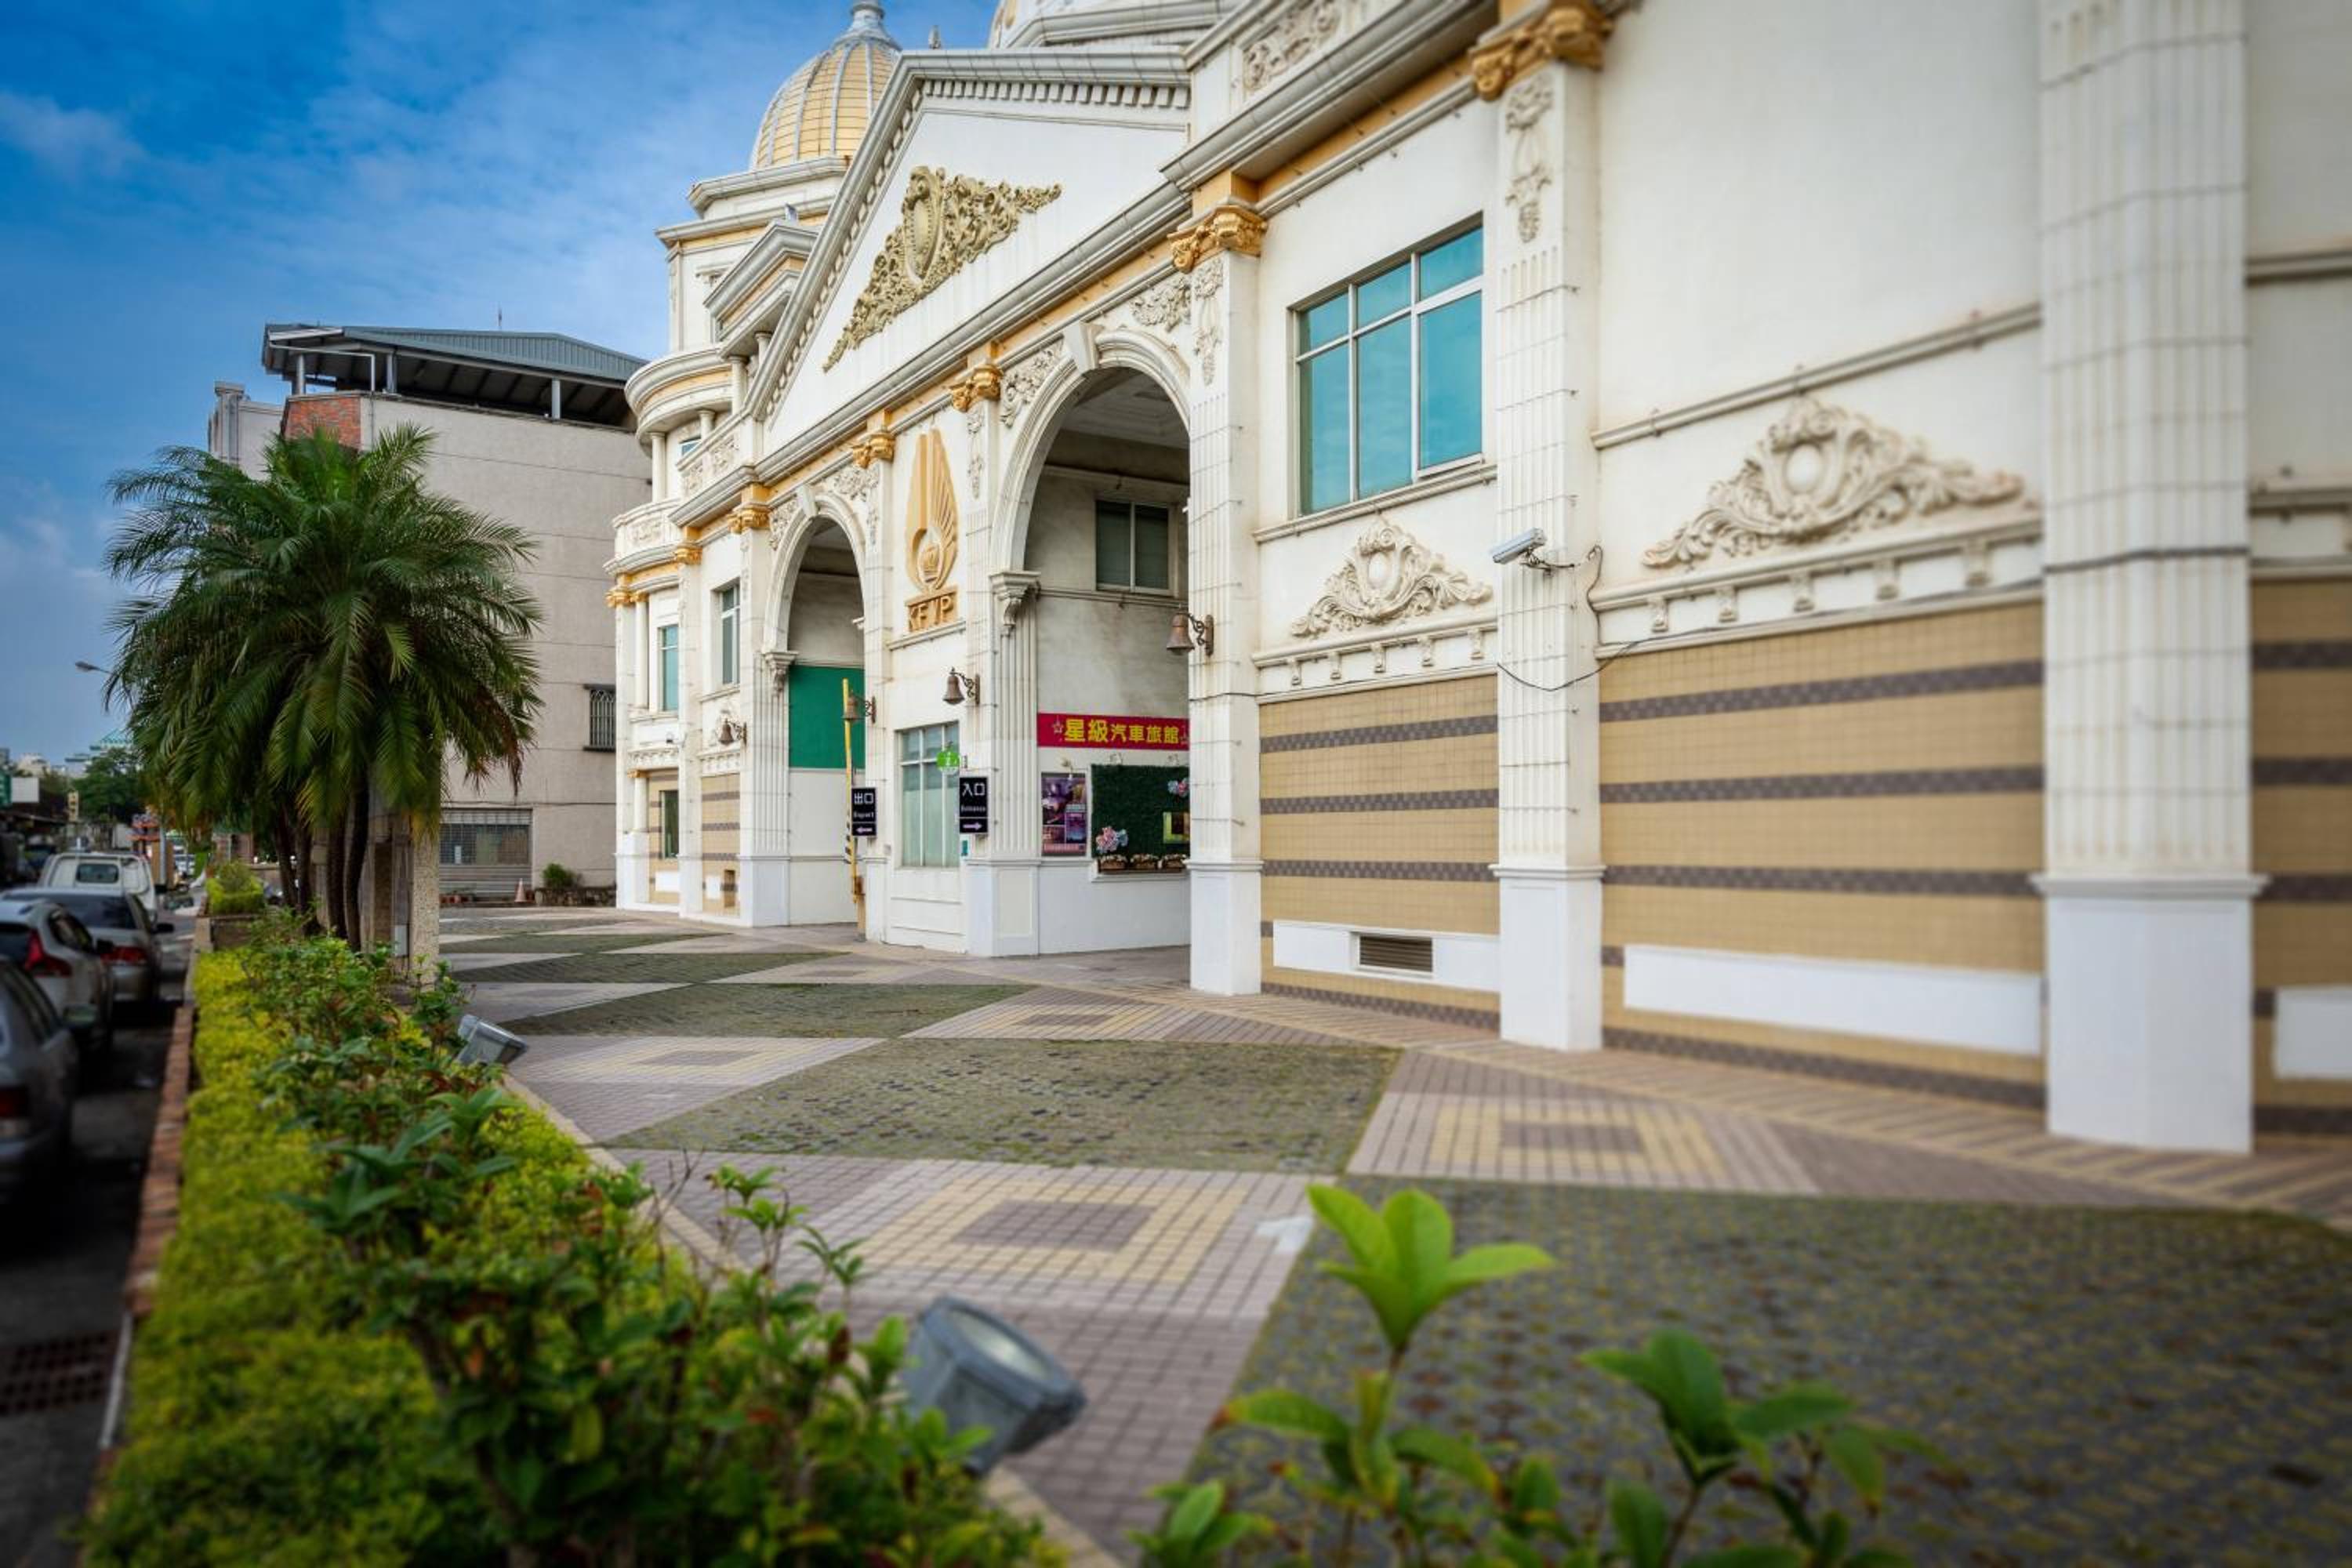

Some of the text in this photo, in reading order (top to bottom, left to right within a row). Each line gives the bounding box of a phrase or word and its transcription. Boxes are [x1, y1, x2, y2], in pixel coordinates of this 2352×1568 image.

[1065, 718, 1179, 744] 星級汽車旅館
[962, 782, 985, 797] 入口
[854, 792, 874, 804] 出口
